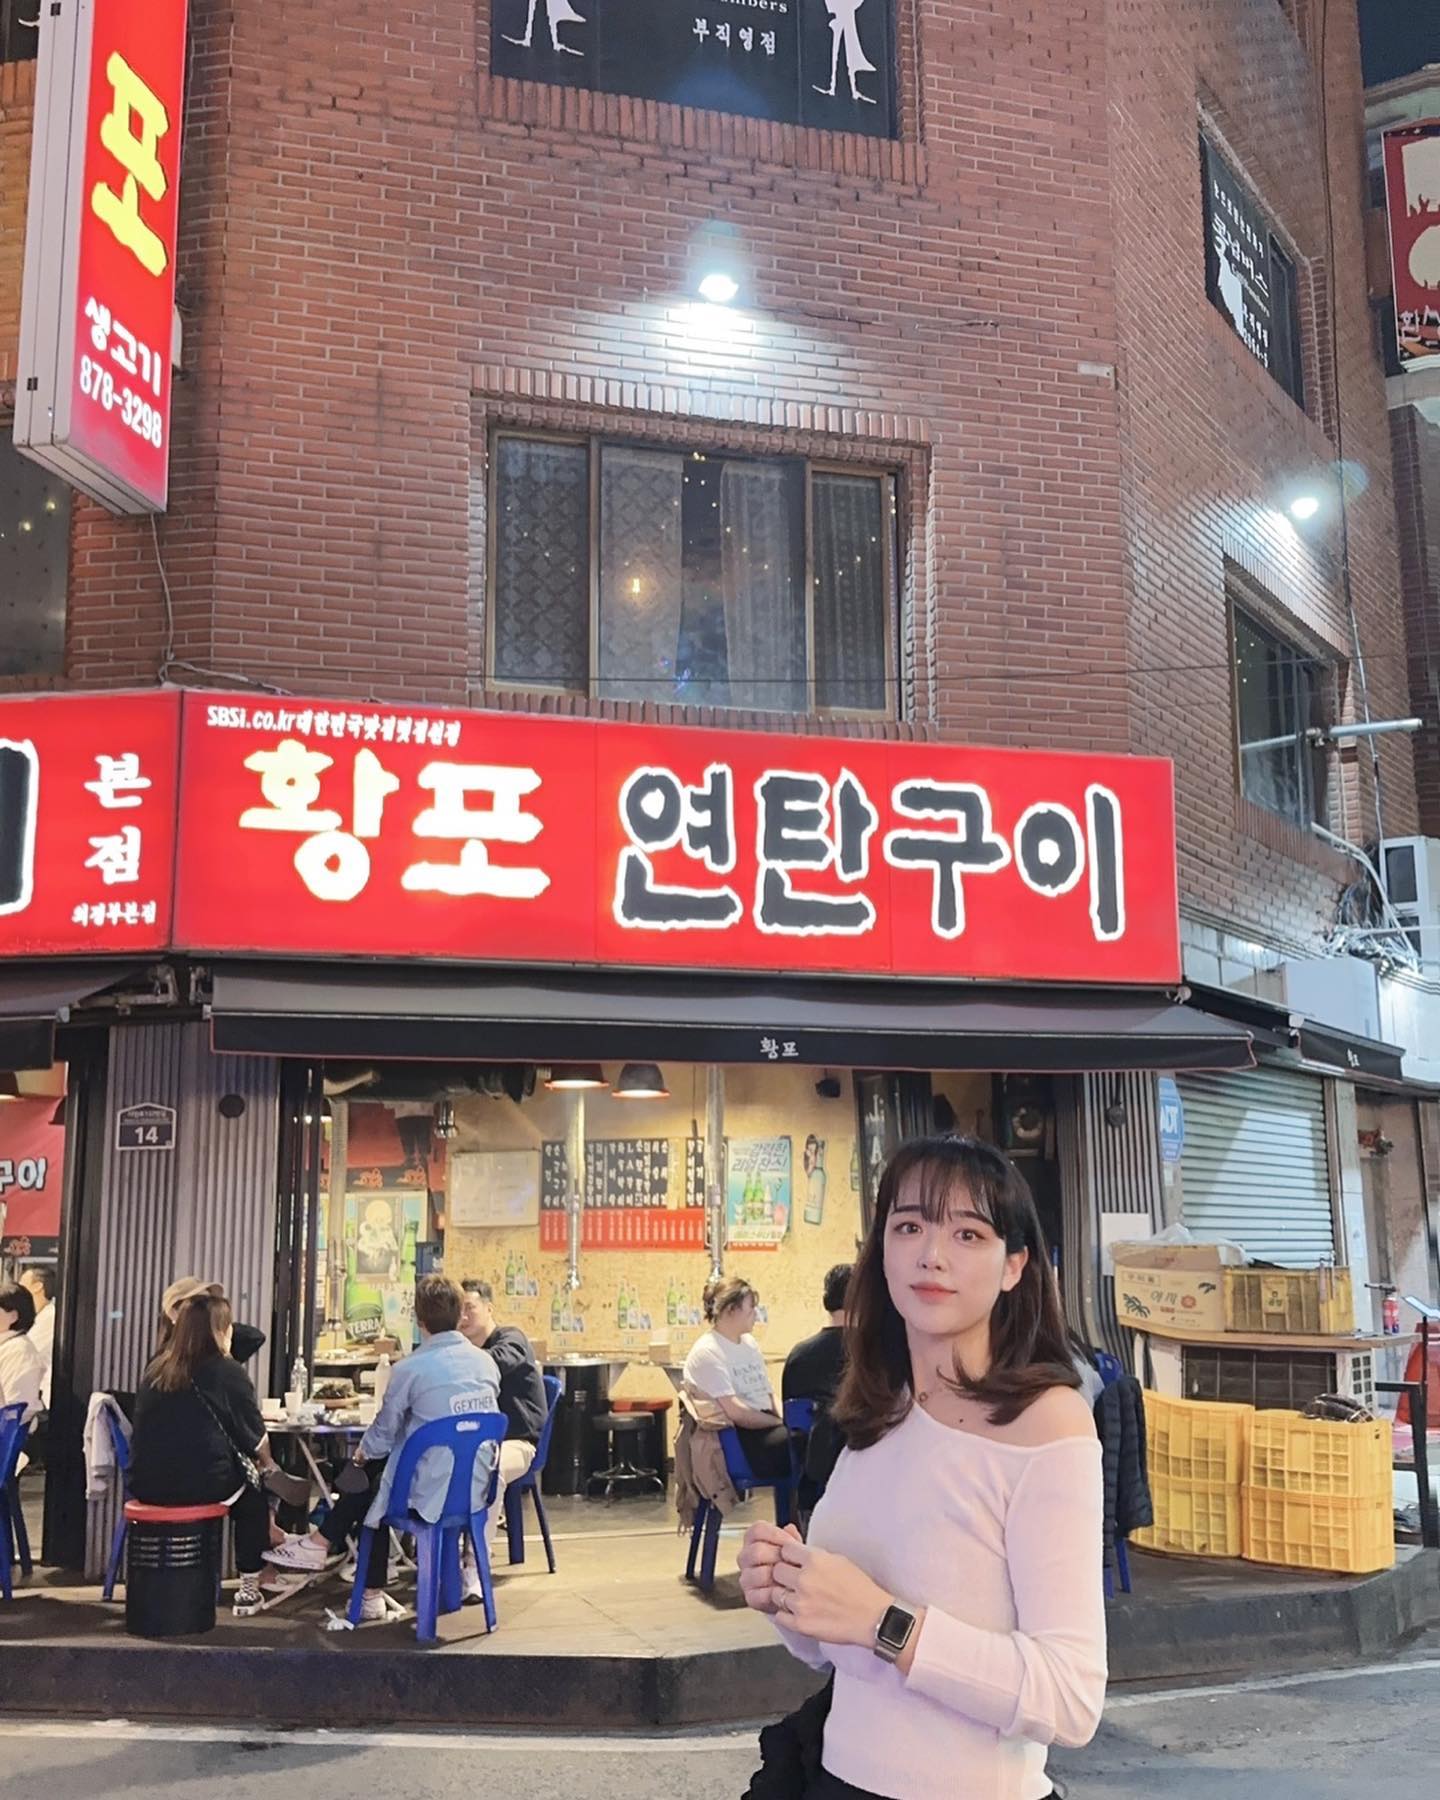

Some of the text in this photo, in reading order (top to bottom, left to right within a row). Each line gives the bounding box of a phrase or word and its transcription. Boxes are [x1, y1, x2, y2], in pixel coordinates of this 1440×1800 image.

[84, 296, 162, 398] 생고기
[79, 354, 163, 449] 878-3298
[238, 738, 551, 902] 황포
[613, 762, 1126, 943] 연탄구이
[760, 1036, 800, 1060] 황포
[134, 1126, 159, 1144] 14
[346, 1317, 381, 1340] TERRA
